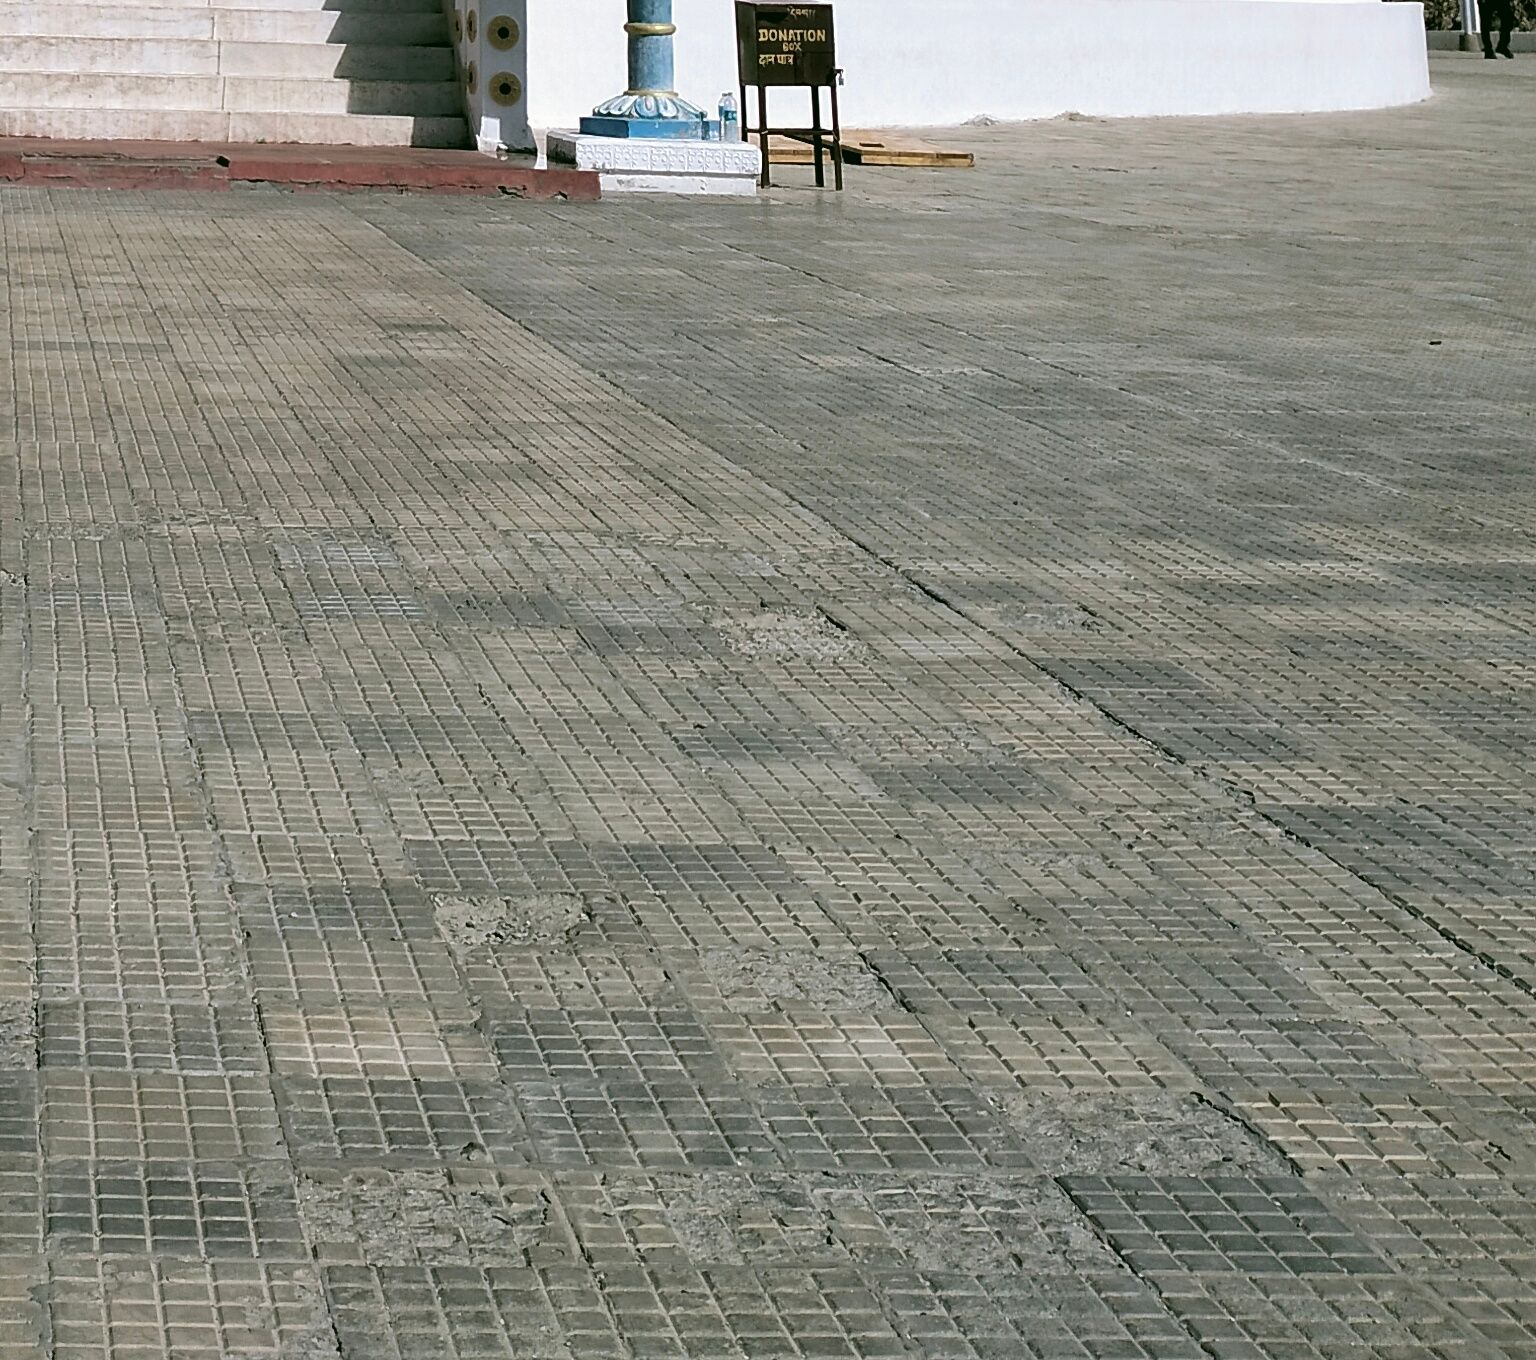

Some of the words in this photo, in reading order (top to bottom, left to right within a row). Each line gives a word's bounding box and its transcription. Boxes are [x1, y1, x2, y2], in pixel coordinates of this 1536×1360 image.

[758, 28, 826, 42] DONATION
[782, 41, 802, 52] BOX
[758, 54, 775, 67] दान
